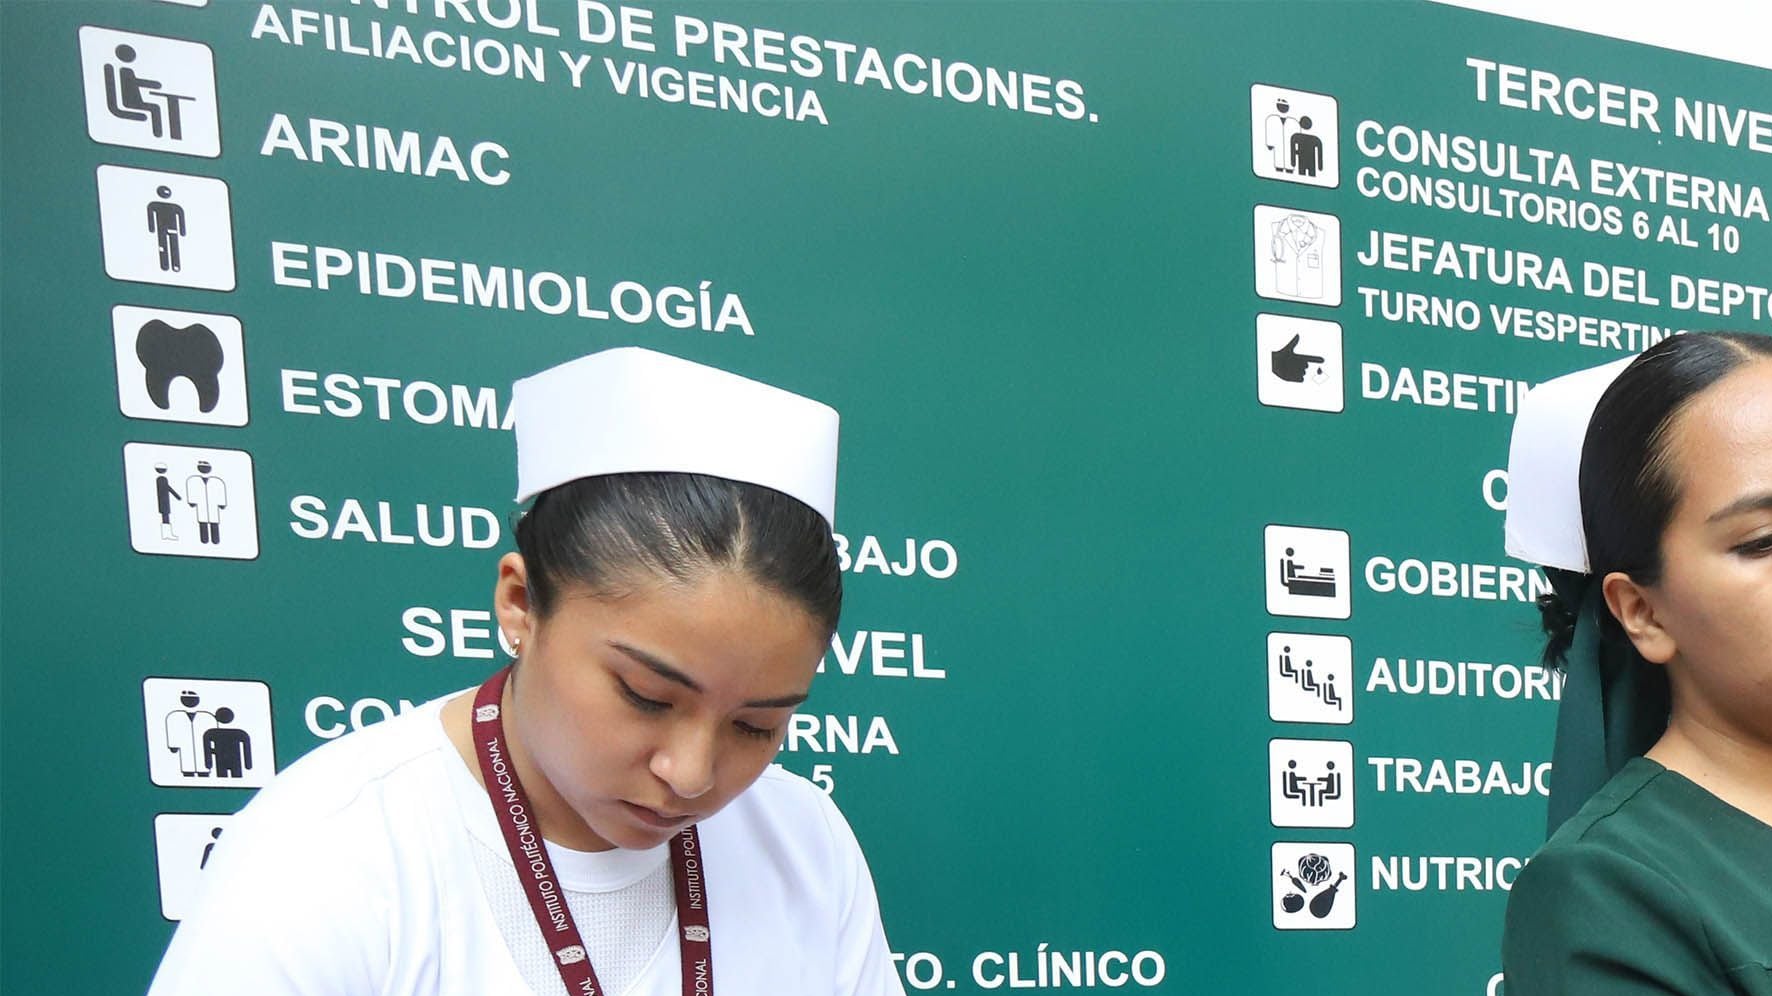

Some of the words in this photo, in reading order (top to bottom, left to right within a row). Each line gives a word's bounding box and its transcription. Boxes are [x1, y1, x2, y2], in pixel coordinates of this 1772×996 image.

[251, 3, 546, 83] AFILIACION
[558, 50, 591, 89] Y
[603, 57, 829, 125] VIGENCIA
[576, 0, 657, 53] DE
[673, 15, 1099, 123] PRESTACIONES.
[1465, 57, 1661, 134] TERCER
[260, 112, 512, 187] ARIMAC
[1355, 119, 1581, 191] CONSULTA
[1590, 157, 1771, 222] EXTERNA
[1355, 166, 1625, 236] CONSULTORIOS
[1632, 212, 1651, 241] 6
[1656, 215, 1700, 249] AL
[1706, 223, 1741, 255] 10
[271, 240, 755, 336] EPIDEMIOLOGÍA
[1357, 230, 1575, 295] JEFATURA
[1583, 264, 1661, 309] DEL
[1357, 286, 1482, 331] TURNO
[1489, 304, 1690, 351] VESPERTIN
[289, 495, 501, 550] SALUD
[1366, 657, 1567, 701] AUDITORI
[778, 713, 900, 755] RNA
[487, 737, 519, 803] NACIONAL
[509, 804, 546, 880] POLITÉCNICO
[1372, 855, 1531, 892] NUTRIC
[538, 880, 569, 932] INSTITUTO
[686, 859, 703, 910] INSTITUTO
[972, 943, 1166, 990] CLÍNICO
